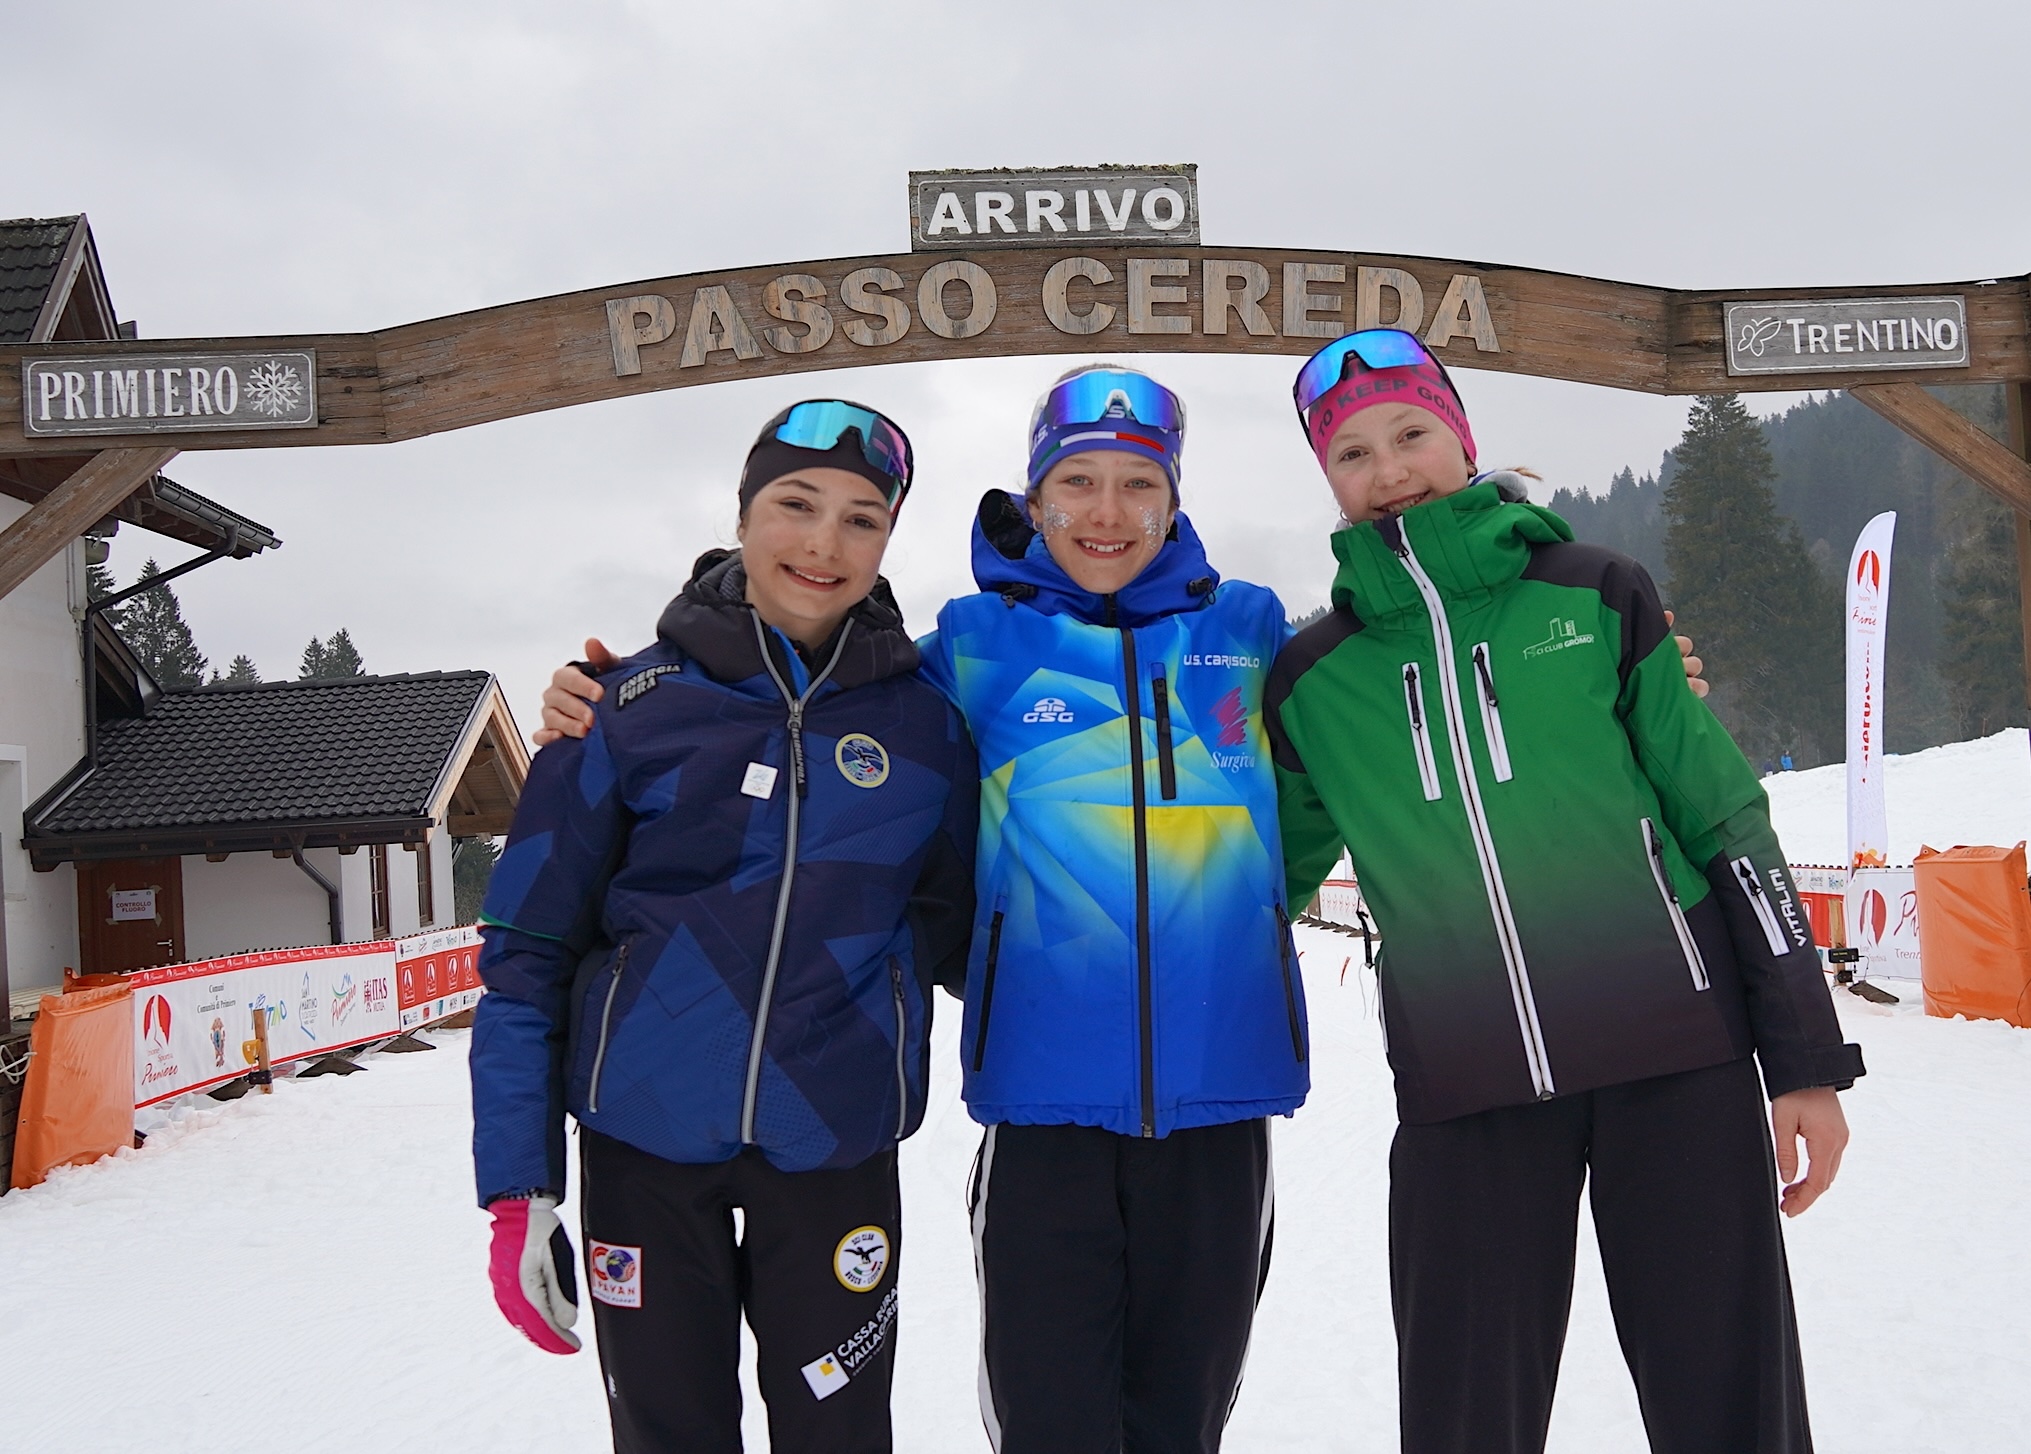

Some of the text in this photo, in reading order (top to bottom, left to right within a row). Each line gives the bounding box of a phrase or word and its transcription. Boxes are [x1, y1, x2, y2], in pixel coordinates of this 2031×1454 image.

[927, 187, 1186, 235] ARRIVO
[604, 256, 1500, 377] PASSO CEREDA
[1786, 317, 1959, 354] TRENTINO
[38, 366, 239, 421] PRIMIERO
[1317, 408, 1333, 437] TO
[1336, 378, 1408, 408] KEEP
[1416, 386, 1467, 440] GOING
[1183, 654, 1202, 666] U.S.
[1544, 642, 1564, 653] CLUB
[1564, 636, 1593, 648] GROMO
[618, 664, 681, 695] ENERGIA
[618, 676, 657, 707] PURA
[1023, 712, 1074, 723] GSG
[1768, 868, 1808, 948] VITALINI
[837, 1321, 879, 1357] CASSA
[876, 1283, 898, 1323] RURA
